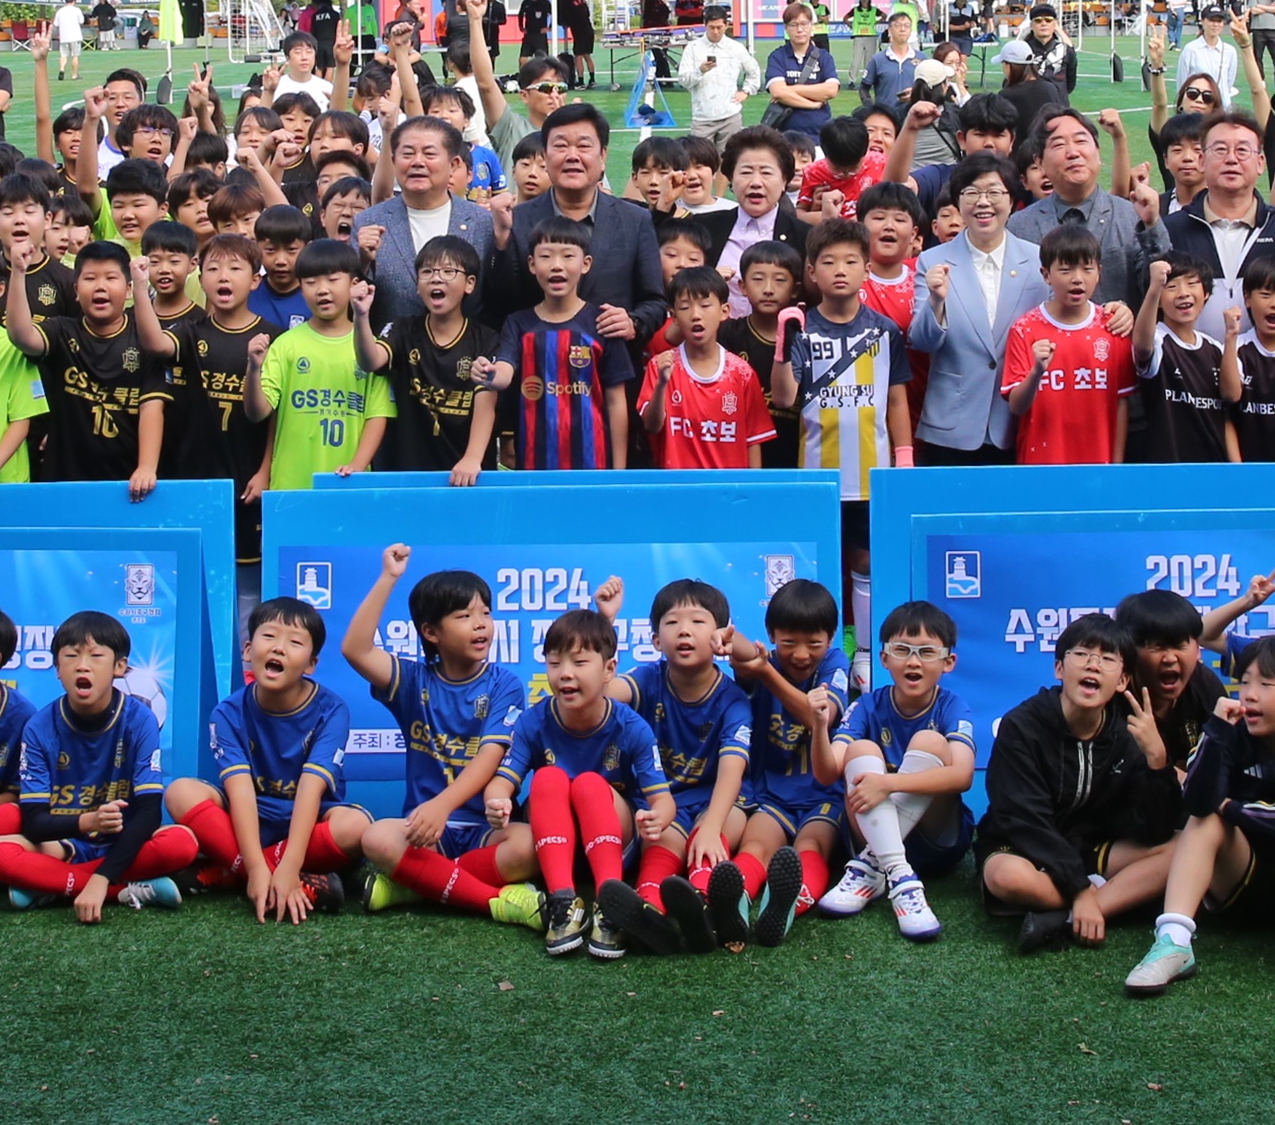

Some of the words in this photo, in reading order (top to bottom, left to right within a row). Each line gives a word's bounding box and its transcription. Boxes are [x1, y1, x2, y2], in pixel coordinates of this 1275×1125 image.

[315, 12, 331, 22] KFA
[813, 341, 835, 361] 99
[545, 380, 592, 397] Spotify
[1073, 367, 1108, 391] 초보
[819, 385, 858, 398] GYUNG
[861, 385, 875, 398] SU
[218, 401, 233, 431] 7
[319, 418, 345, 448] 10
[669, 416, 694, 439] FC
[700, 419, 737, 443] 초보
[1145, 554, 1241, 597] 2024
[496, 567, 592, 612] 2024
[358, 735, 387, 749] 주최
